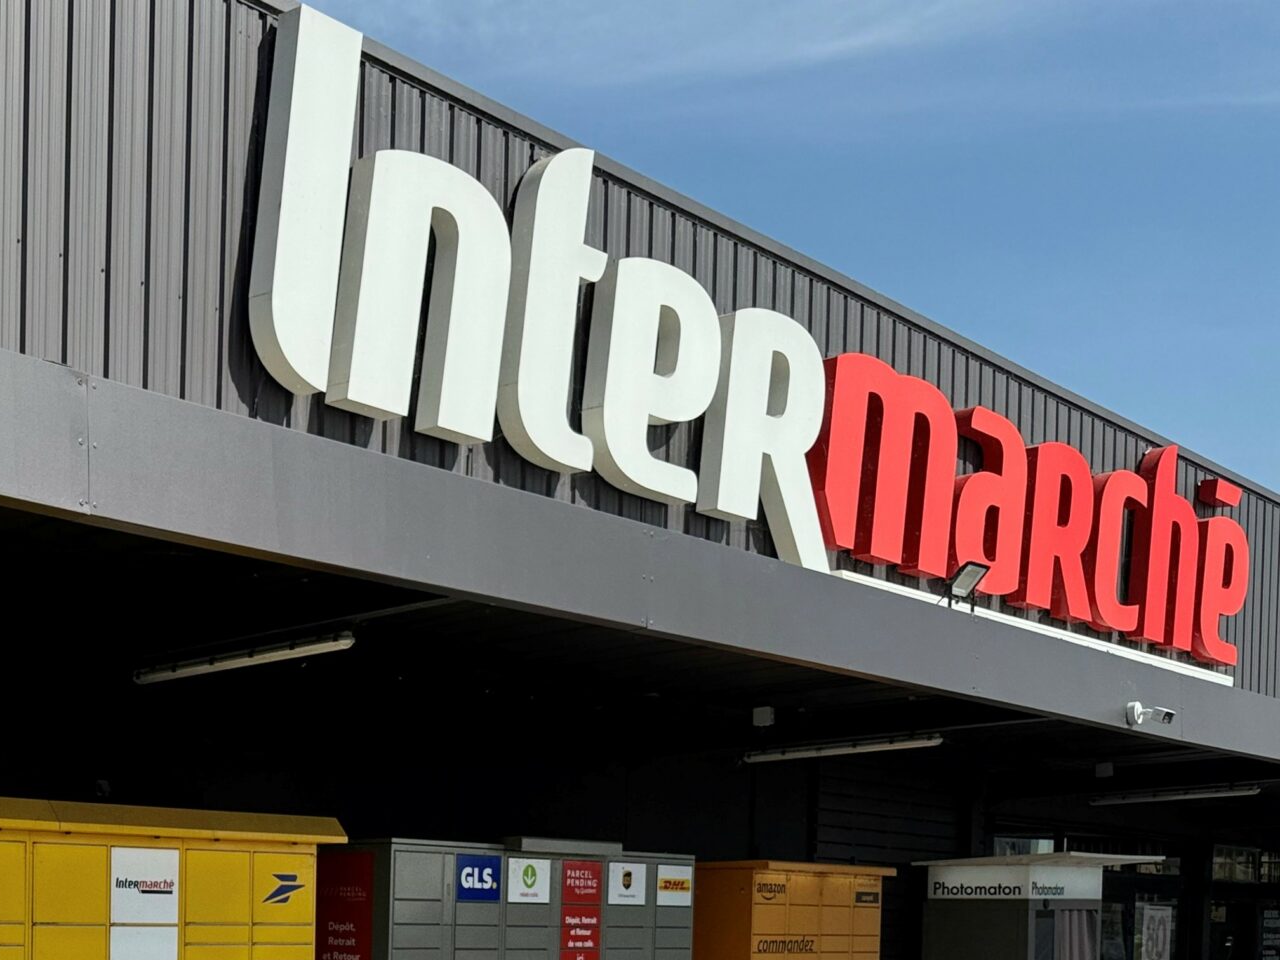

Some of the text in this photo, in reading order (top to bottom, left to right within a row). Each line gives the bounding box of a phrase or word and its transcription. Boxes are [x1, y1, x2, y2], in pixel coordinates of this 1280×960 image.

[566, 869, 593, 879] PARCEL
[566, 877, 598, 888] PENDING
[663, 880, 685, 890] DHL
[756, 882, 786, 895] amazon
[933, 881, 1022, 896] Photomaton
[1031, 881, 1065, 896] Photomaton
[328, 922, 356, 933] Dépôt,
[328, 937, 356, 946] Retrait
[757, 936, 815, 952] commandez
[332, 952, 361, 960] Retour
